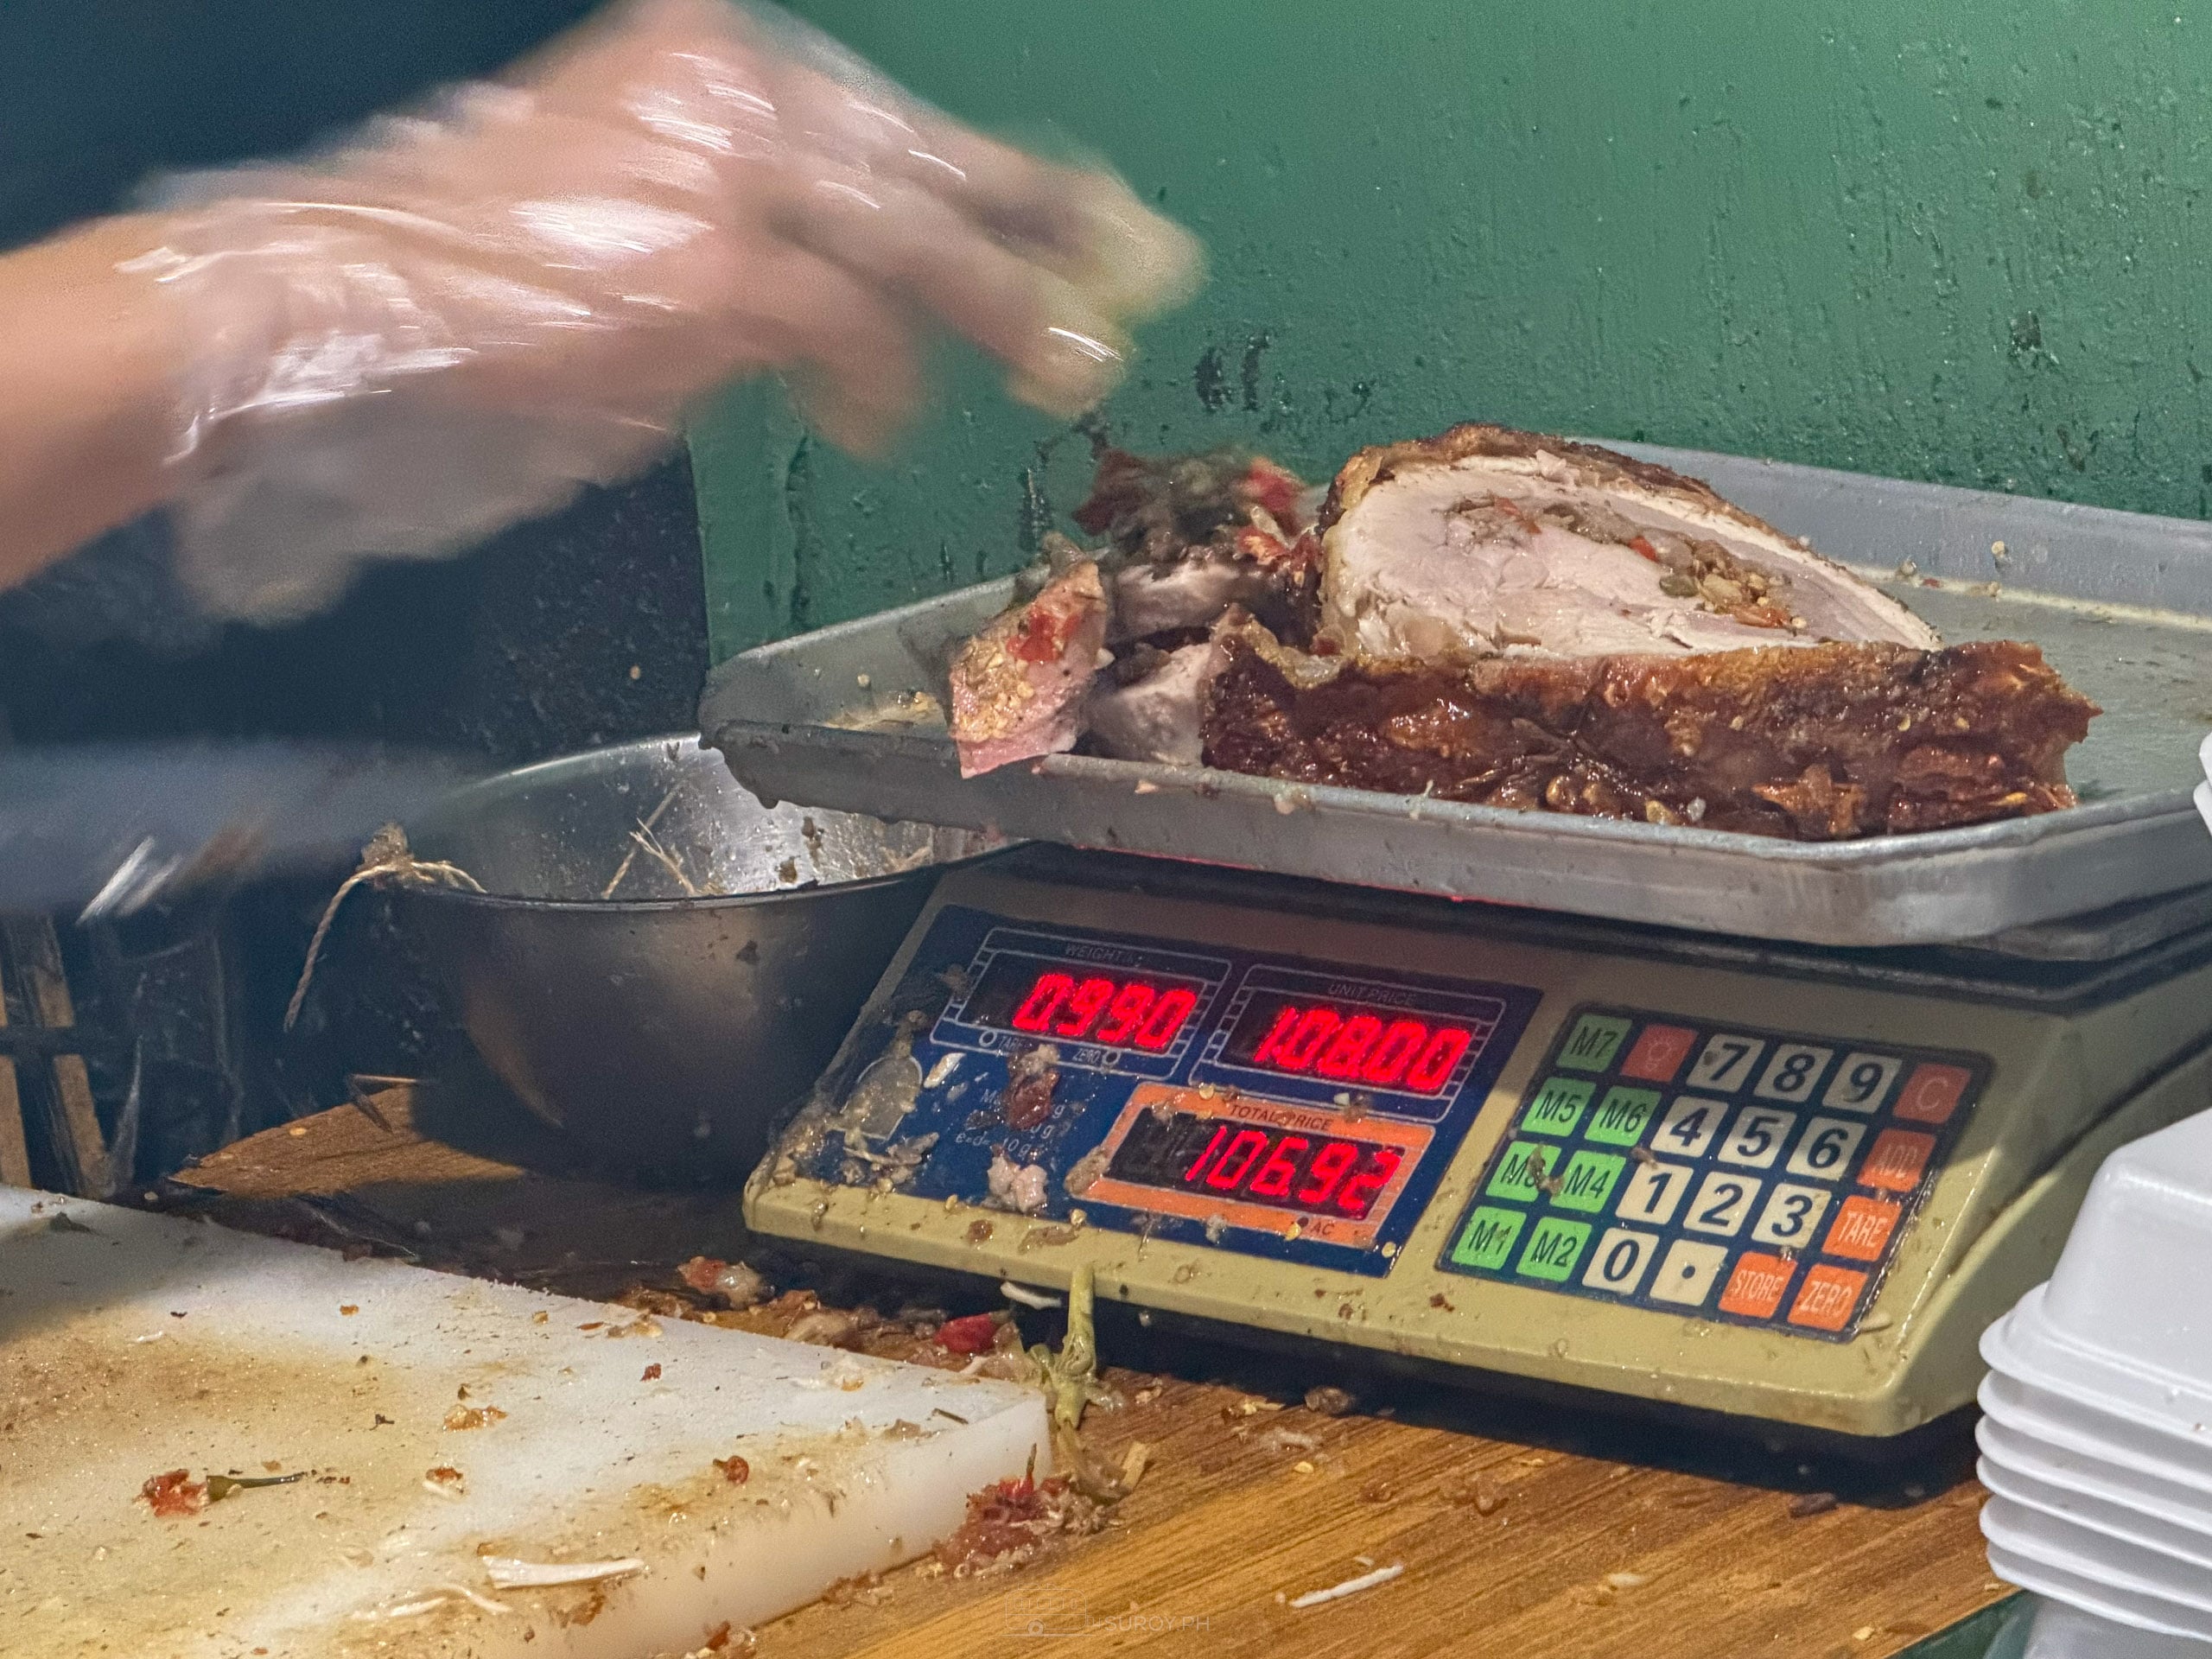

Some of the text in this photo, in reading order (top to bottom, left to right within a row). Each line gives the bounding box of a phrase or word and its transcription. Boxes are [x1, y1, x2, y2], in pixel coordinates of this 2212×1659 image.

[1065, 943, 1123, 962] WEIGHT
[1328, 982, 1418, 1006] UNIT PRICE
[1571, 1026, 1617, 1056] M7
[1717, 1043, 1751, 1080] 7
[1772, 1054, 1815, 1092] 8
[1841, 1062, 1884, 1103] 9
[1916, 1077, 1949, 1109] C
[1535, 1090, 1582, 1122] M5
[1599, 1099, 1642, 1132] M6
[1670, 1109, 1703, 1147] 4
[1737, 1118, 1775, 1157] 5
[1808, 1128, 1849, 1169] 6
[1874, 1143, 1920, 1176] ADD
[1562, 1165, 1606, 1198] M4
[1645, 1173, 1674, 1213] 1
[1700, 1183, 1745, 1224] 2
[1771, 1194, 1813, 1236] 3
[1310, 1222, 1335, 1236] AC
[1468, 1223, 1510, 1257] M1
[1840, 1212, 1888, 1247] TARE
[1535, 1232, 1576, 1268] M2
[1603, 1237, 1639, 1280] 0
[1733, 1270, 1783, 1302] STORE
[1798, 1283, 1851, 1317] ZERO
